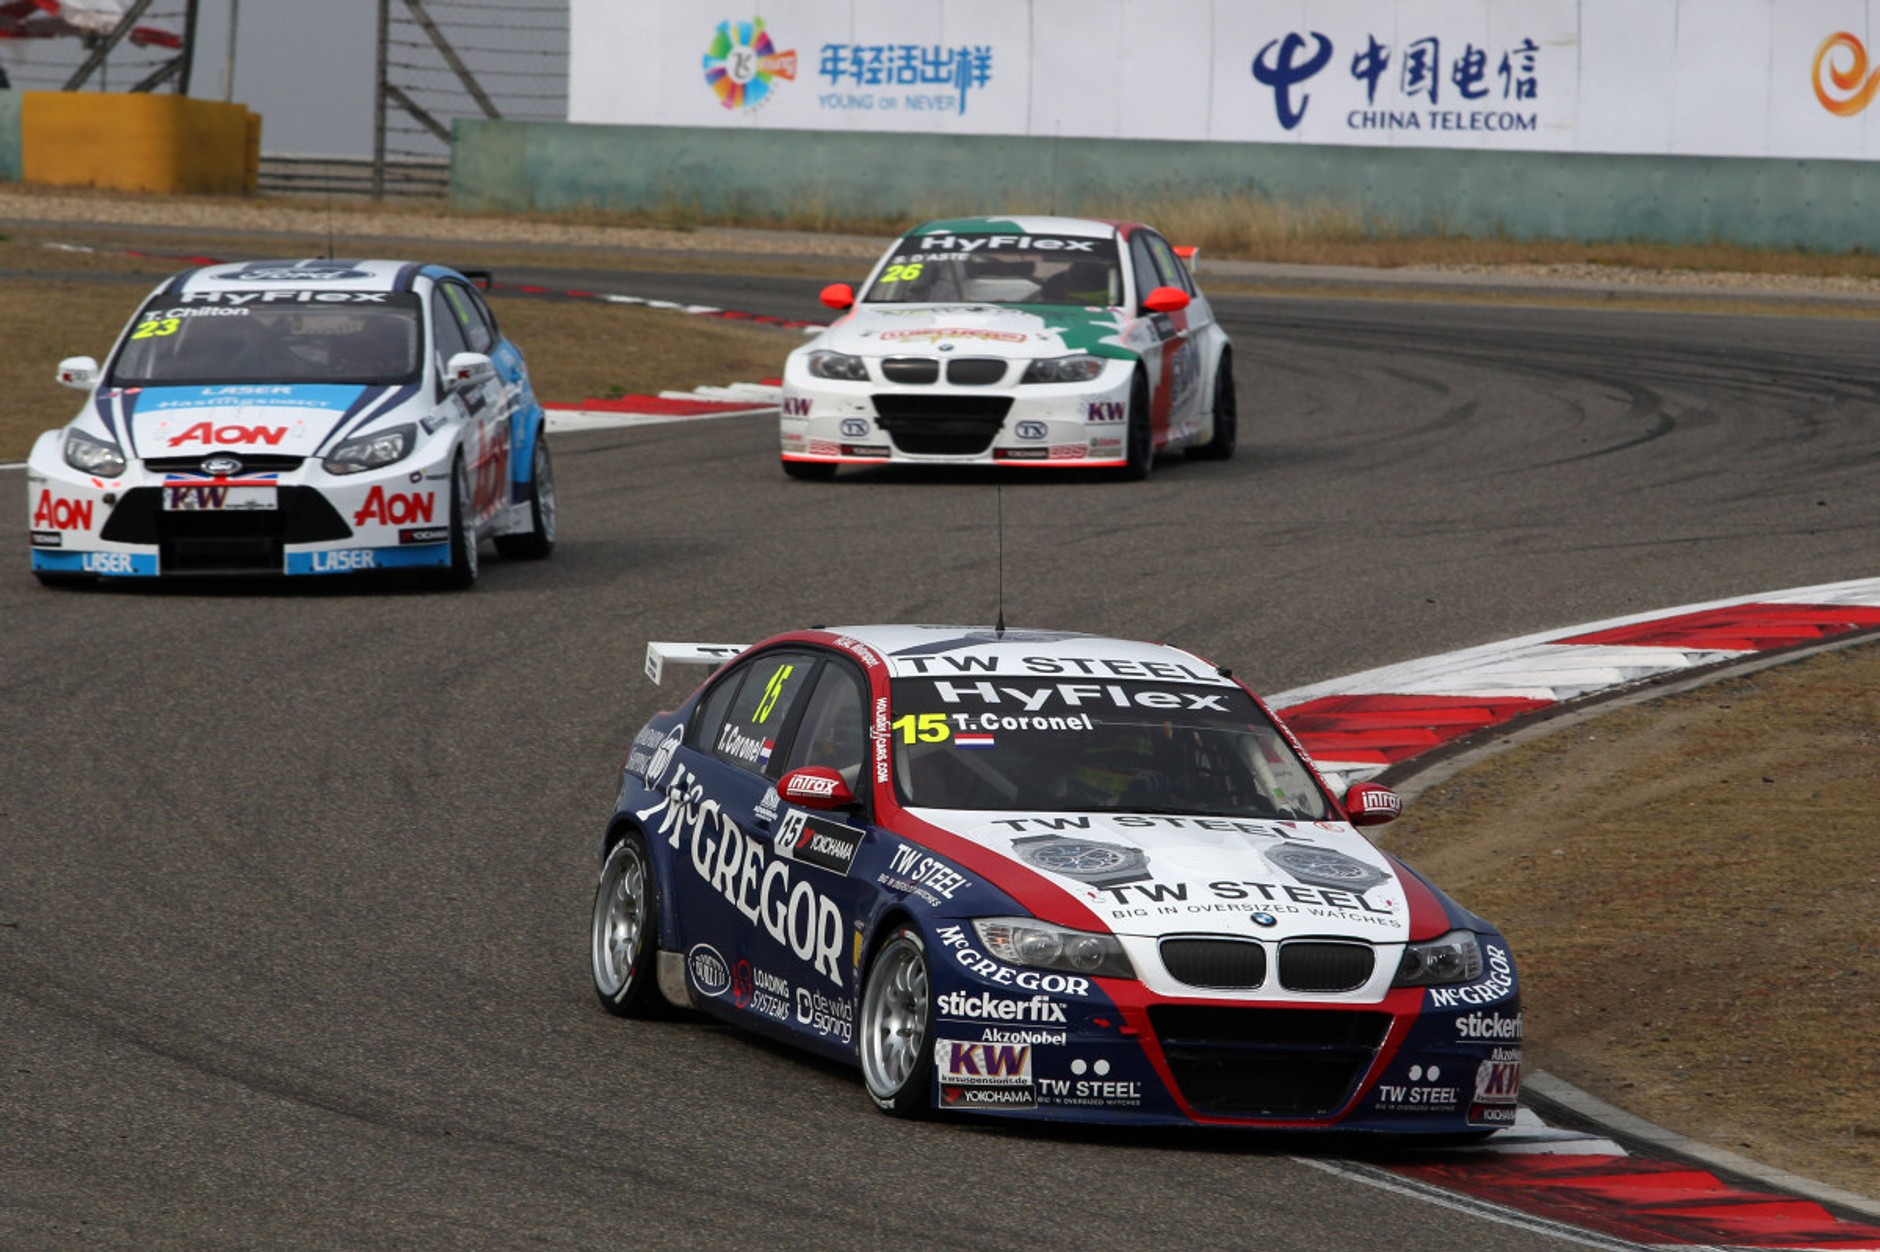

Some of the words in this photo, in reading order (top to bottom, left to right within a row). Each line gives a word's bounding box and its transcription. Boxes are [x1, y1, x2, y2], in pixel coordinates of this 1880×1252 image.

[819, 44, 992, 116] 年轻活出样
[1351, 33, 1540, 106] 中国电信
[819, 94, 873, 110] YOUNG
[1347, 110, 1420, 129] CHINA
[1429, 112, 1537, 130] TELECOM
[921, 236, 1094, 251] HyFlex
[880, 264, 923, 282] 26
[179, 290, 387, 304] HyFlex
[131, 318, 181, 339] 23
[202, 386, 292, 395] LASER
[783, 398, 811, 415] KW
[1088, 402, 1125, 421] KW
[83, 554, 132, 572] LASER
[313, 551, 374, 571] LASER
[898, 656, 1000, 673] TW
[1023, 657, 1222, 683] STEEL
[752, 665, 793, 723] 15
[935, 682, 1231, 712] HyFlex
[893, 713, 950, 745] 15
[781, 815, 803, 848] 15
[992, 815, 1091, 832] TW
[1114, 816, 1314, 842] STEEL
[889, 843, 922, 875] TW
[912, 857, 967, 899] STEEL
[1100, 883, 1188, 905] TW
[1209, 881, 1393, 915] STEEL
[1112, 908, 1148, 919] BIG
[1157, 906, 1178, 915] IN
[1188, 903, 1300, 913] OVERSIZED
[1308, 907, 1401, 929] WATCHES
[753, 967, 790, 999] LOADING
[750, 990, 791, 1021] SYSTEMS
[937, 991, 1066, 1023] stickerfix
[982, 1028, 1066, 1045] AkzoNobel
[949, 1043, 1030, 1077] KW
[964, 1088, 1032, 1103] YOKOHAMA
[1038, 1078, 1071, 1096] TW
[1076, 1081, 1141, 1098] STEEL
[1380, 1085, 1405, 1103] TW
[1409, 1086, 1459, 1104] STEEL
